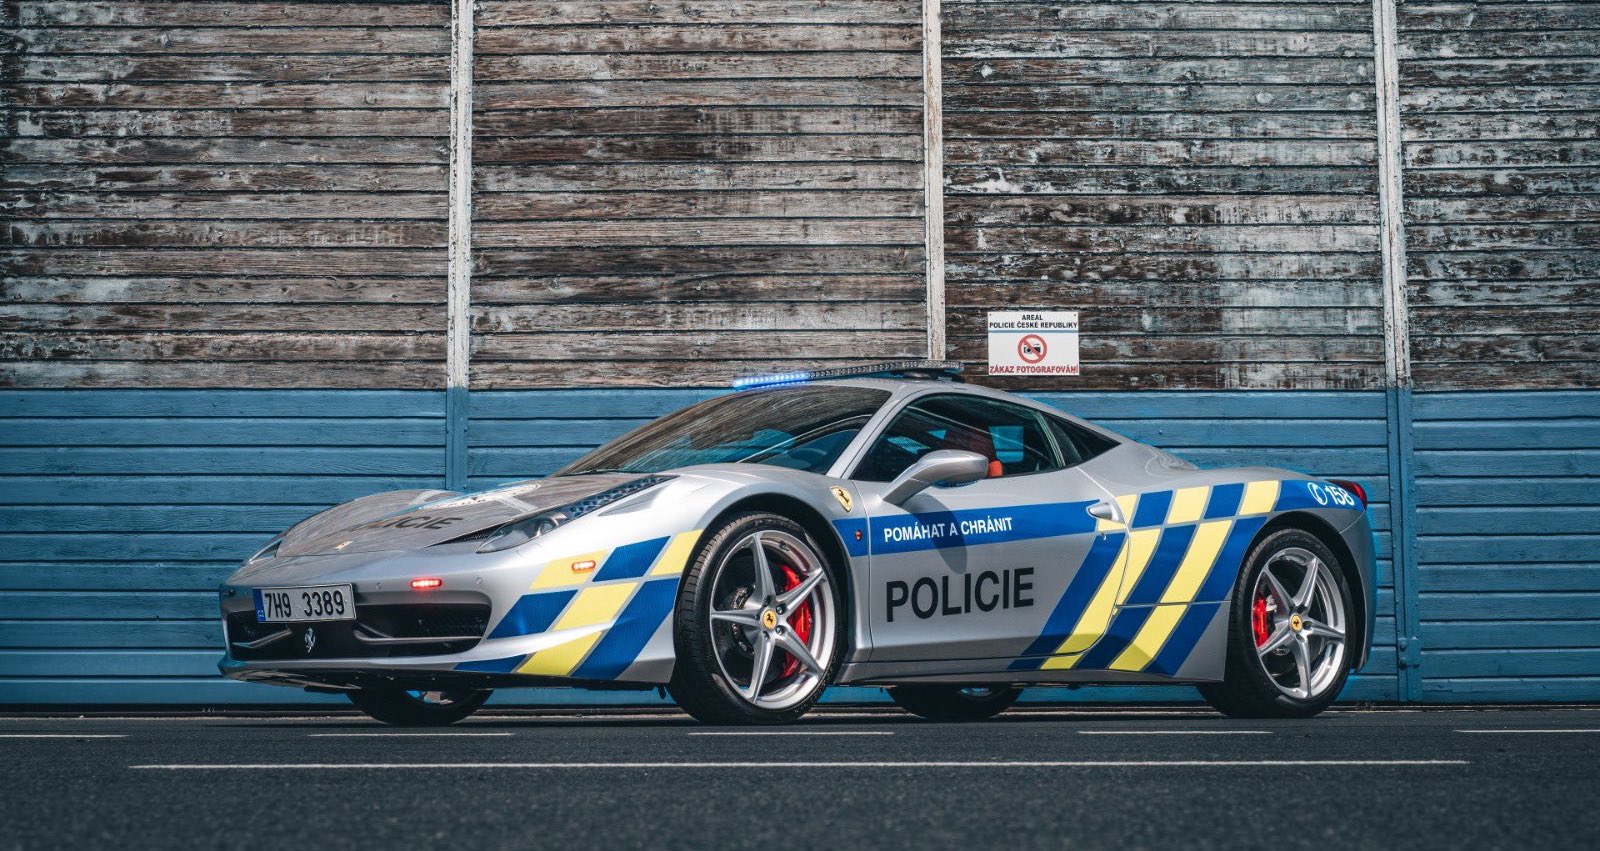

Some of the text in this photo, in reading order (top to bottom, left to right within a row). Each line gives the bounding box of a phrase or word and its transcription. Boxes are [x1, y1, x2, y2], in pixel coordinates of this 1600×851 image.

[1016, 320, 1039, 329] ČESKÉ
[989, 364, 1079, 374] ZÁKAZ FOTOGRAFOVÁNÍ
[1324, 485, 1355, 506] 158
[884, 515, 1013, 543] POMÁHAT A CHRÁNIT
[264, 589, 345, 618] 7H9 3389
[886, 567, 1035, 623] POLICIE
